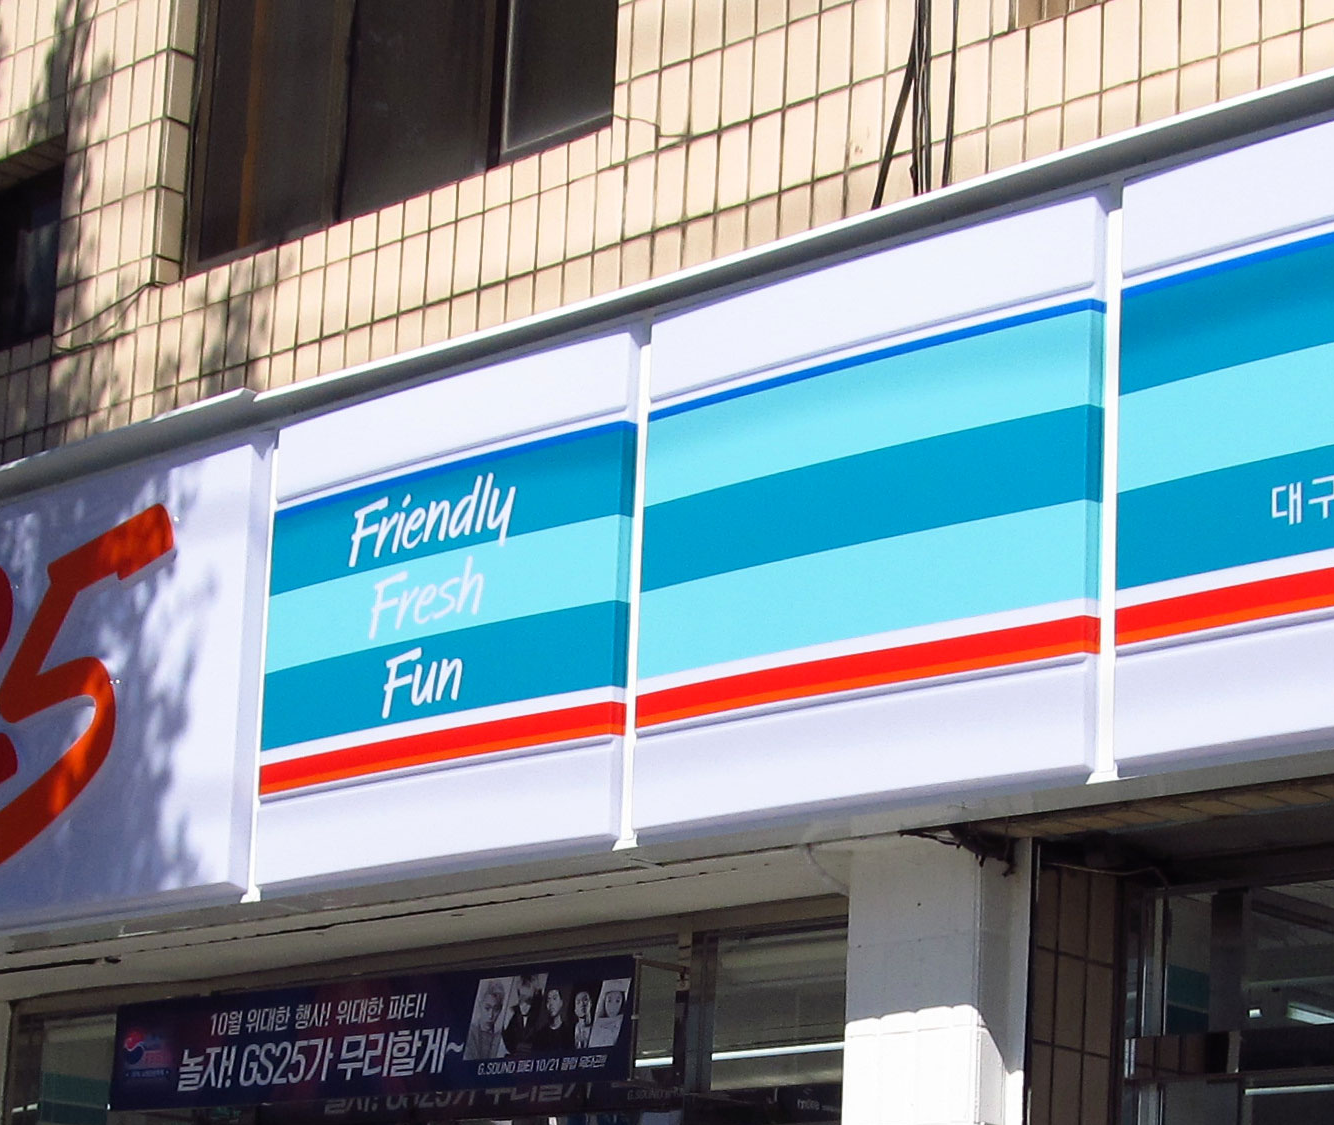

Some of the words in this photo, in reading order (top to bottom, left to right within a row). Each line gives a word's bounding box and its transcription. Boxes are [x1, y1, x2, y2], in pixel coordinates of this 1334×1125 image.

[348, 472, 517, 568] Friendly
[368, 555, 485, 641] Fresh
[381, 646, 463, 720] Fun
[209, 1011, 244, 1036] 10월
[245, 1006, 291, 1033] 위대한
[295, 1001, 332, 1030] 행사!
[335, 996, 384, 1025] 위대한
[386, 992, 428, 1020] 파티!
[177, 1045, 237, 1092] 놀자!
[239, 1036, 335, 1087] GS25가
[536, 1057, 559, 1071] 10/21
